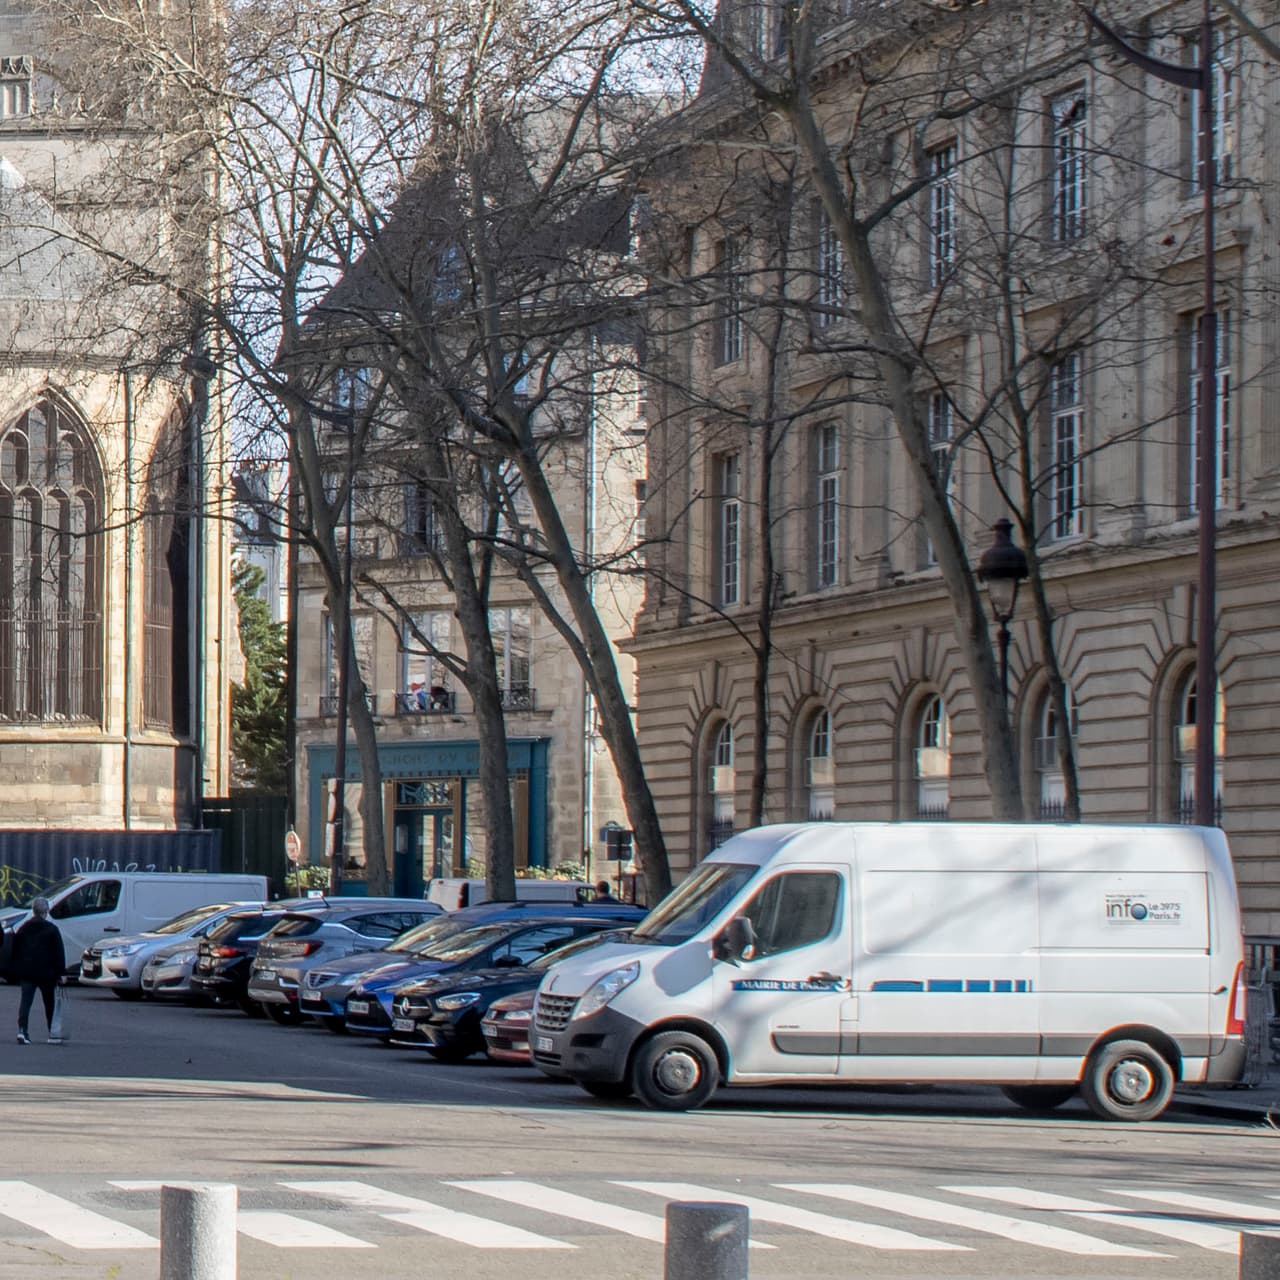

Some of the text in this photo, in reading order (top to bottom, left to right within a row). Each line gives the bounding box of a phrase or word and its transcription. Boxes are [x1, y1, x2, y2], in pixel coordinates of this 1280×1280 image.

[1105, 899, 1148, 920] info
[1148, 903, 1181, 911] Le 3975
[1148, 912, 1181, 920] Paris.fr
[742, 980, 780, 990] MAIRIE
[782, 980, 797, 990] DE
